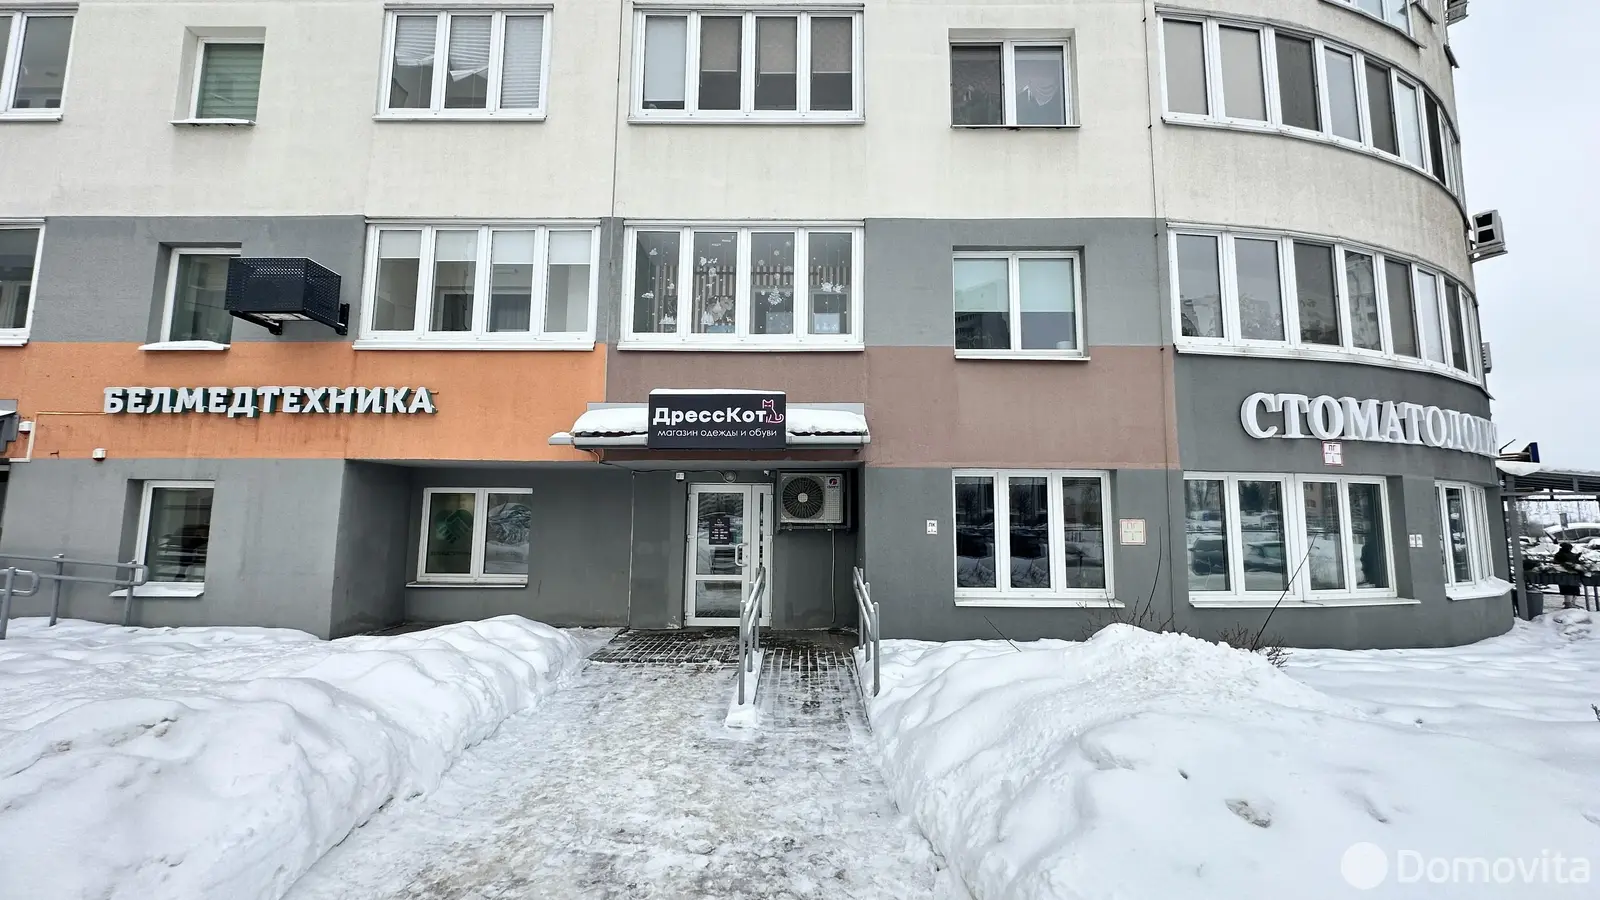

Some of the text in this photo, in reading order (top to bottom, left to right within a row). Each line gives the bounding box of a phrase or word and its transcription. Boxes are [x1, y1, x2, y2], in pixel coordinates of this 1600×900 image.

[103, 386, 436, 418] БЕЛМЕДТЕХНИКА
[653, 407, 766, 426] ДрессКот
[657, 427, 777, 438] магазин одежды и обуви
